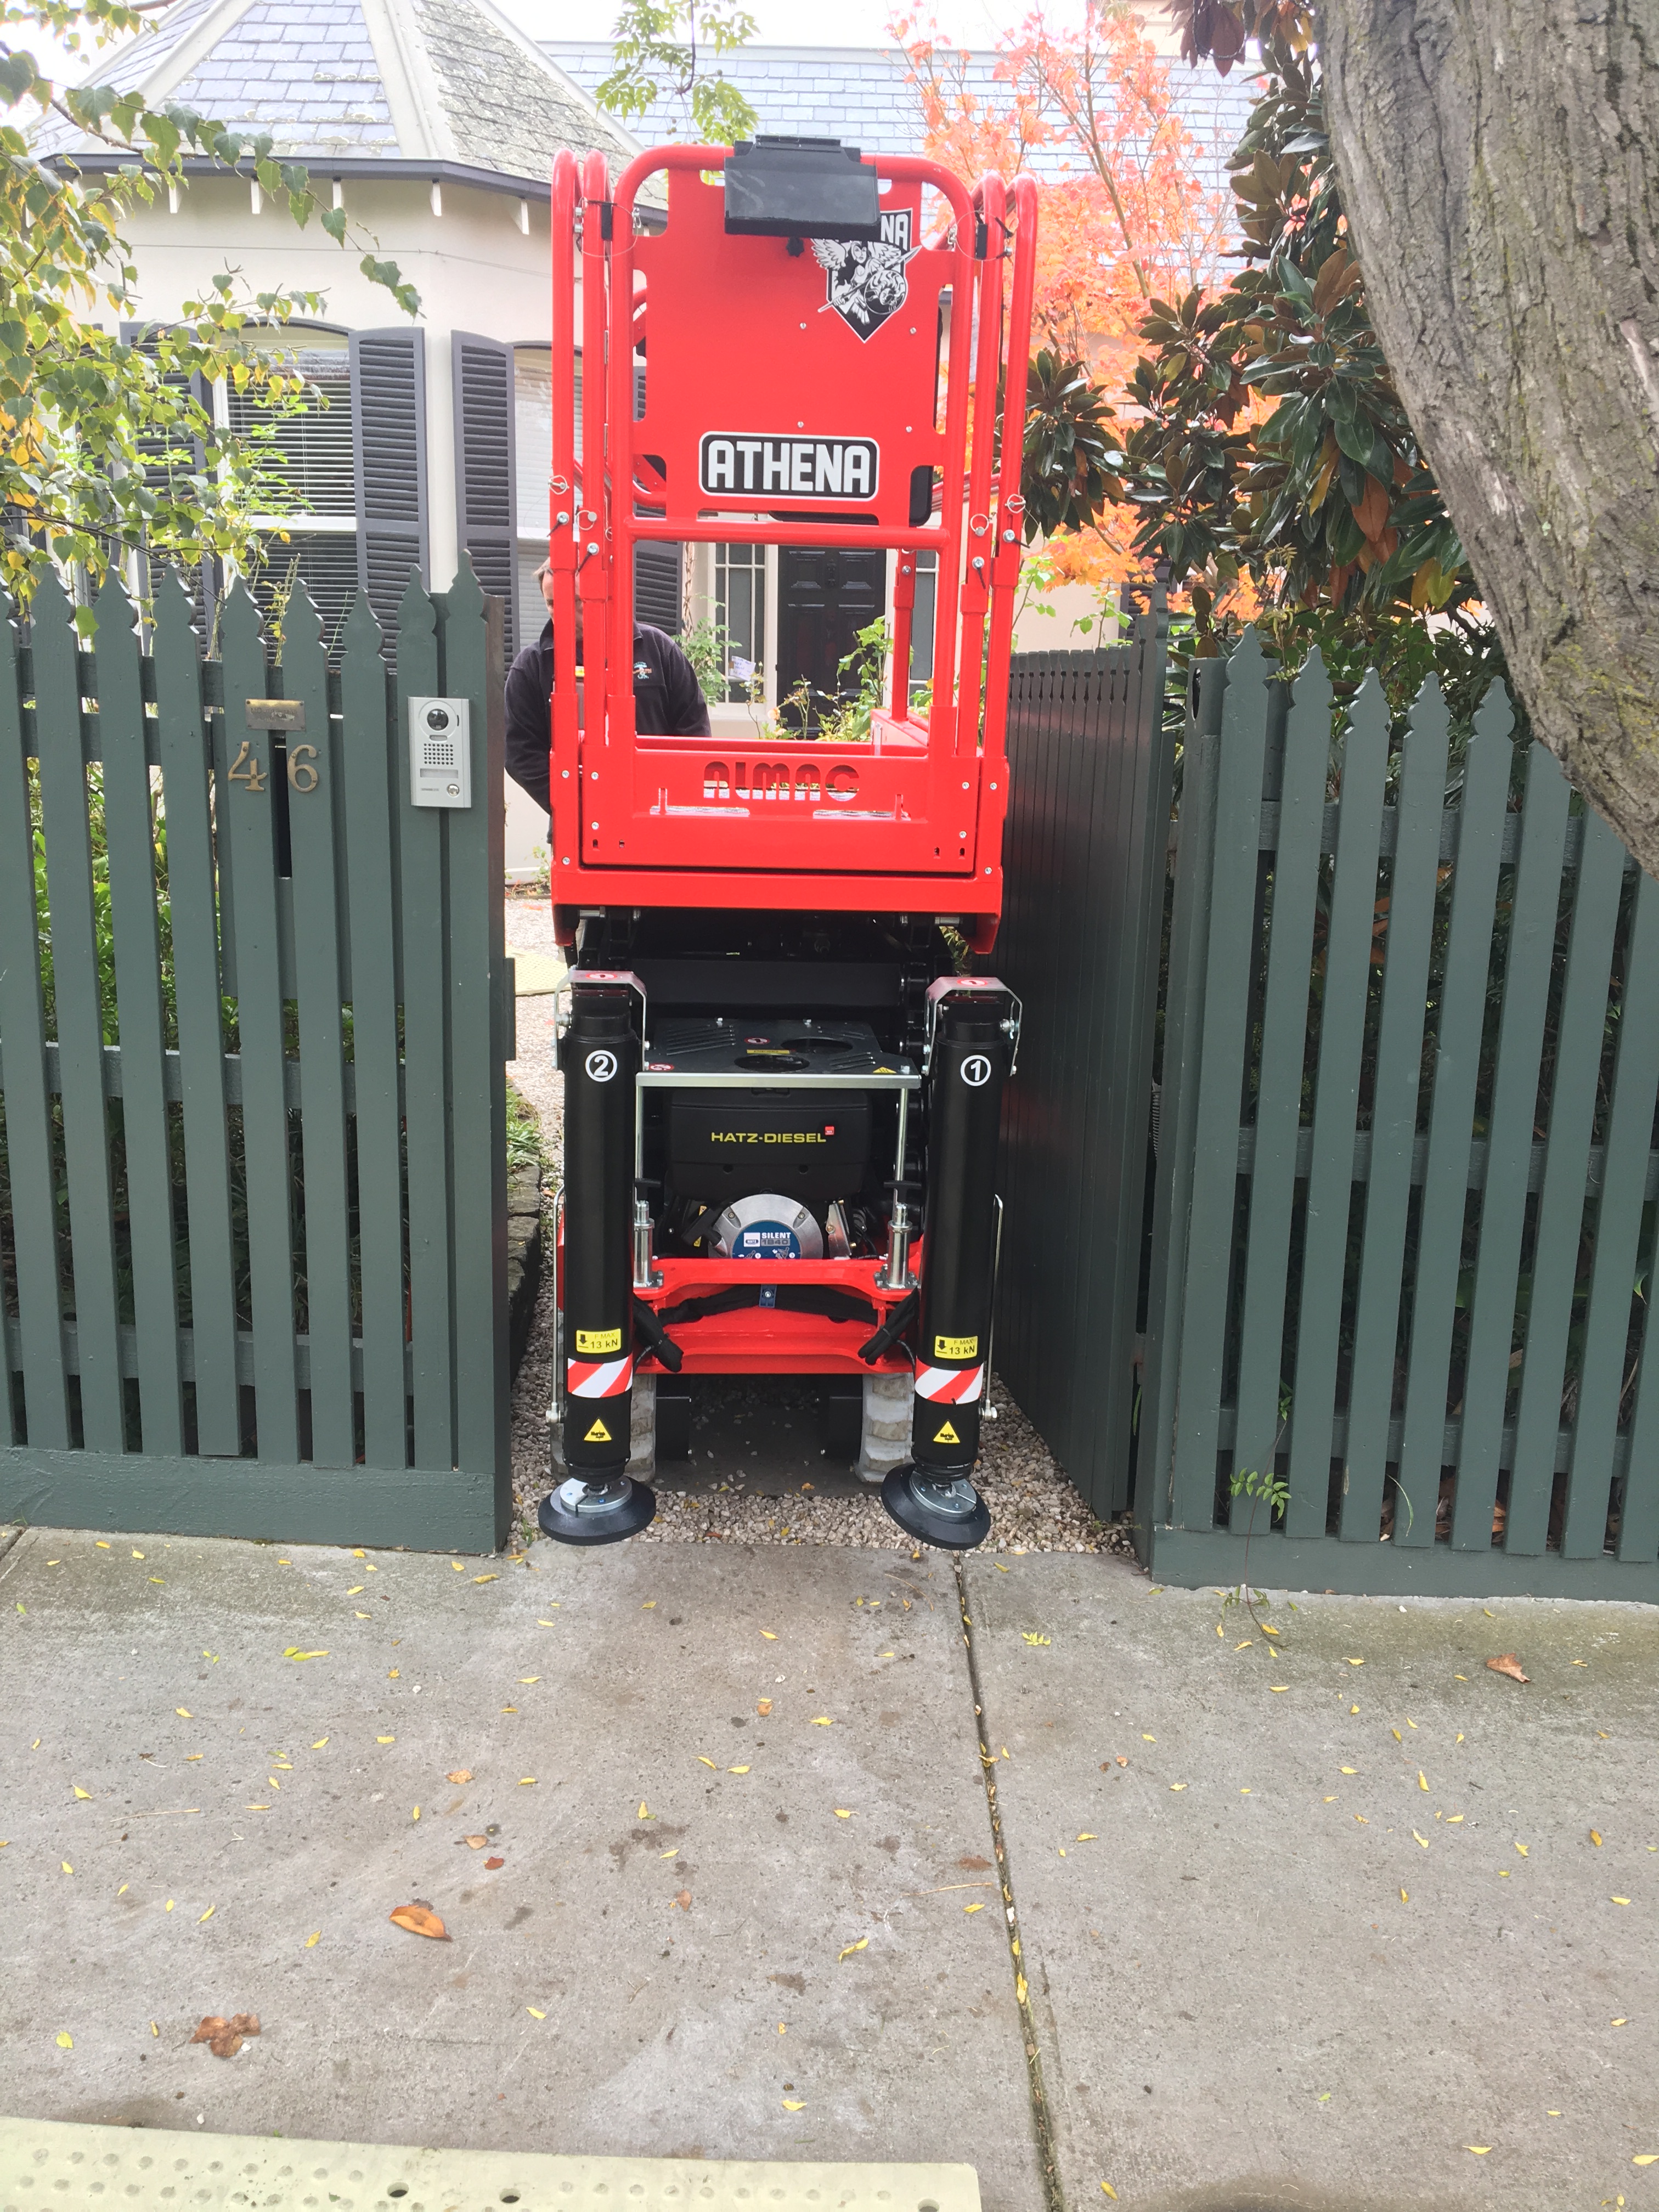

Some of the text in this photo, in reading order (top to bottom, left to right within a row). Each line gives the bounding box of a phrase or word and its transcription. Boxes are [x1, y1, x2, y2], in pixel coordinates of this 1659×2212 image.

[708, 440, 870, 493] ATHENA
[703, 761, 860, 802] ALMAC
[594, 1055, 608, 1076] 2
[970, 1060, 981, 1081] 1
[711, 1132, 827, 1143] HATZ-DIESEL
[606, 1339, 618, 1348] kN
[964, 1345, 975, 1355] kN
